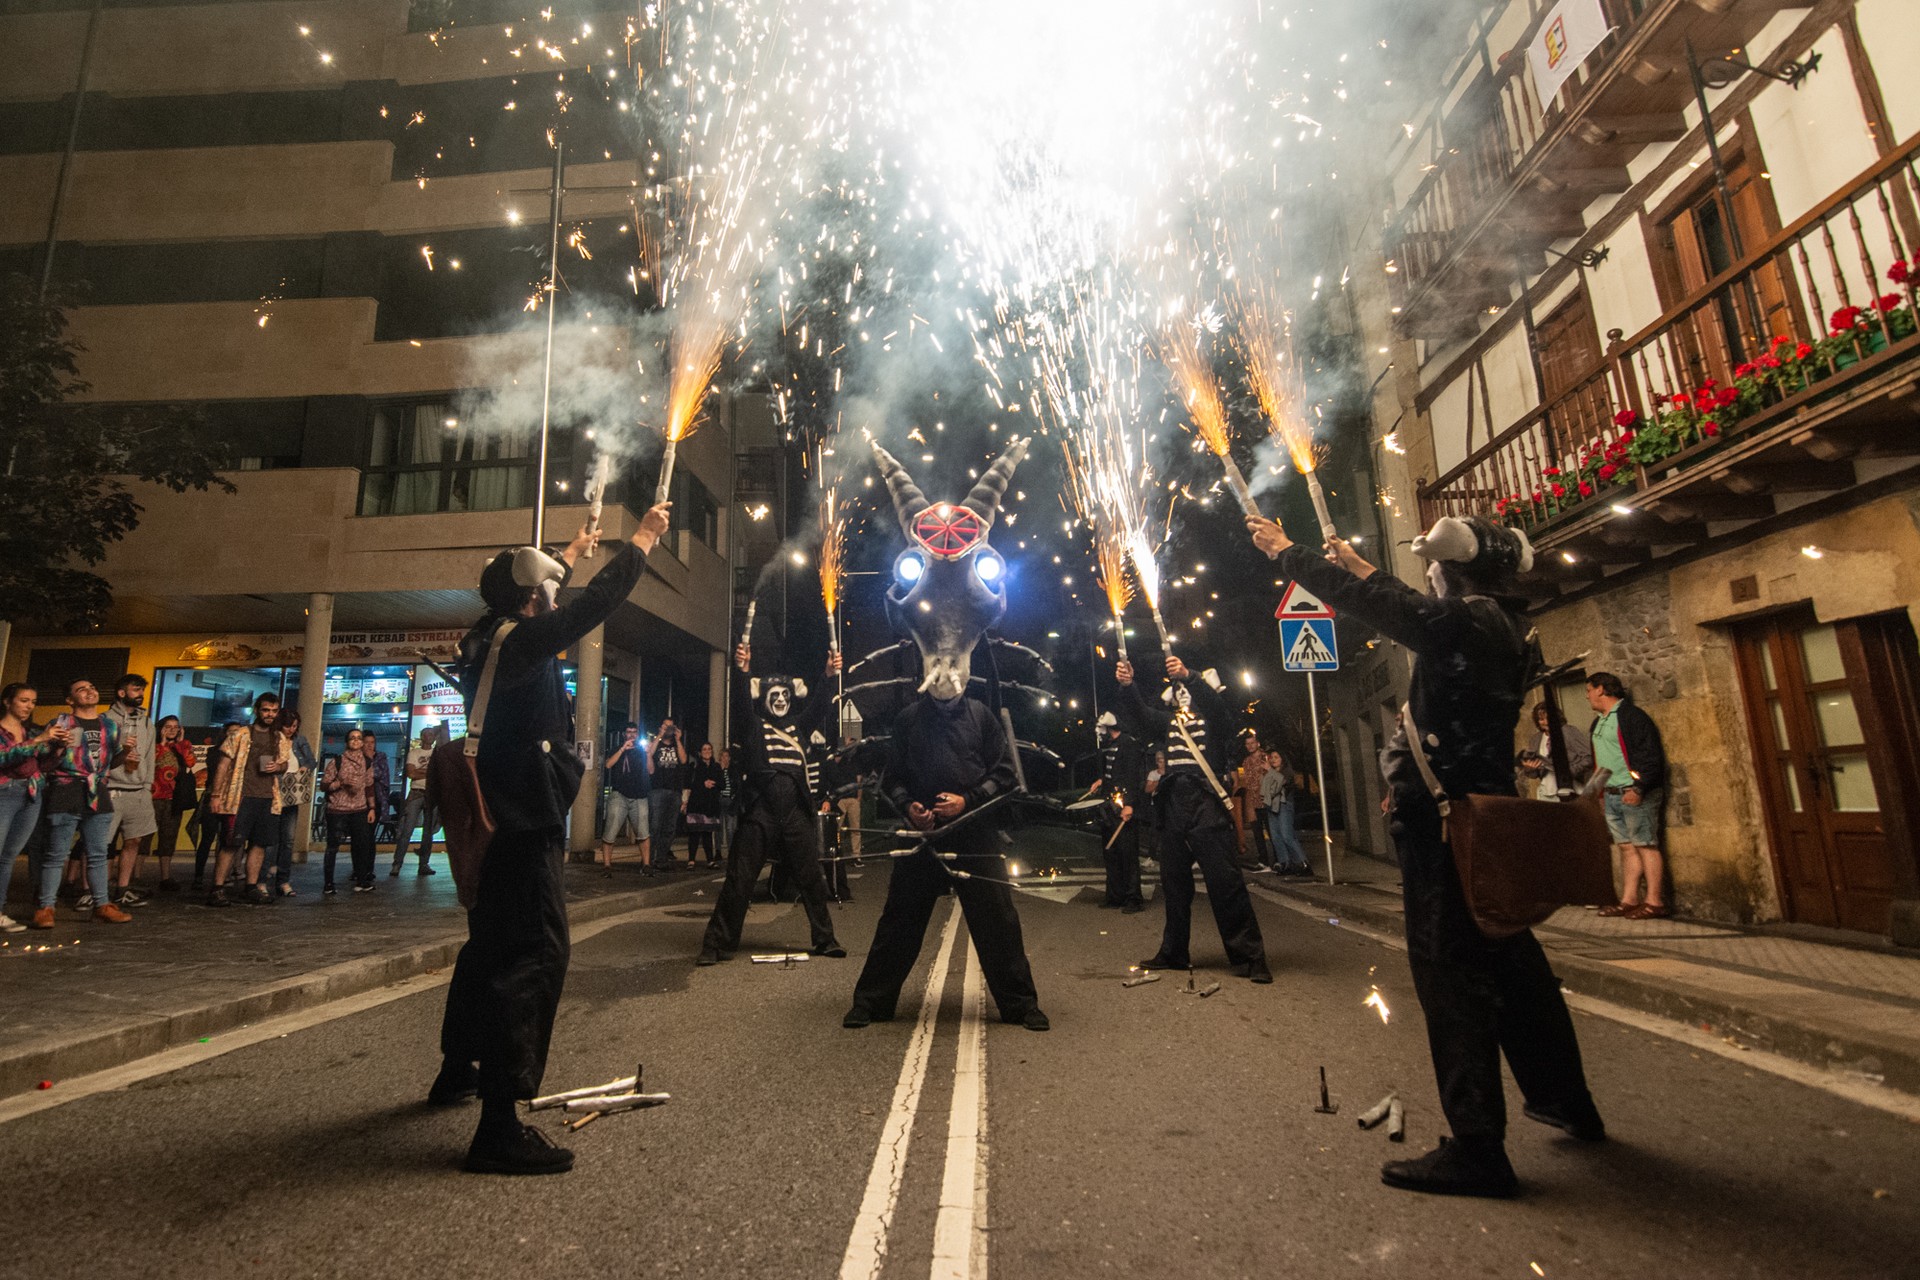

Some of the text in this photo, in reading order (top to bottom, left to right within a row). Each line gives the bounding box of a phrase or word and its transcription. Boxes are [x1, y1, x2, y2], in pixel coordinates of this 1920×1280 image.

[330, 631, 462, 644] ONNER KEBAB ESTRELLA
[444, 705, 453, 714] 24
